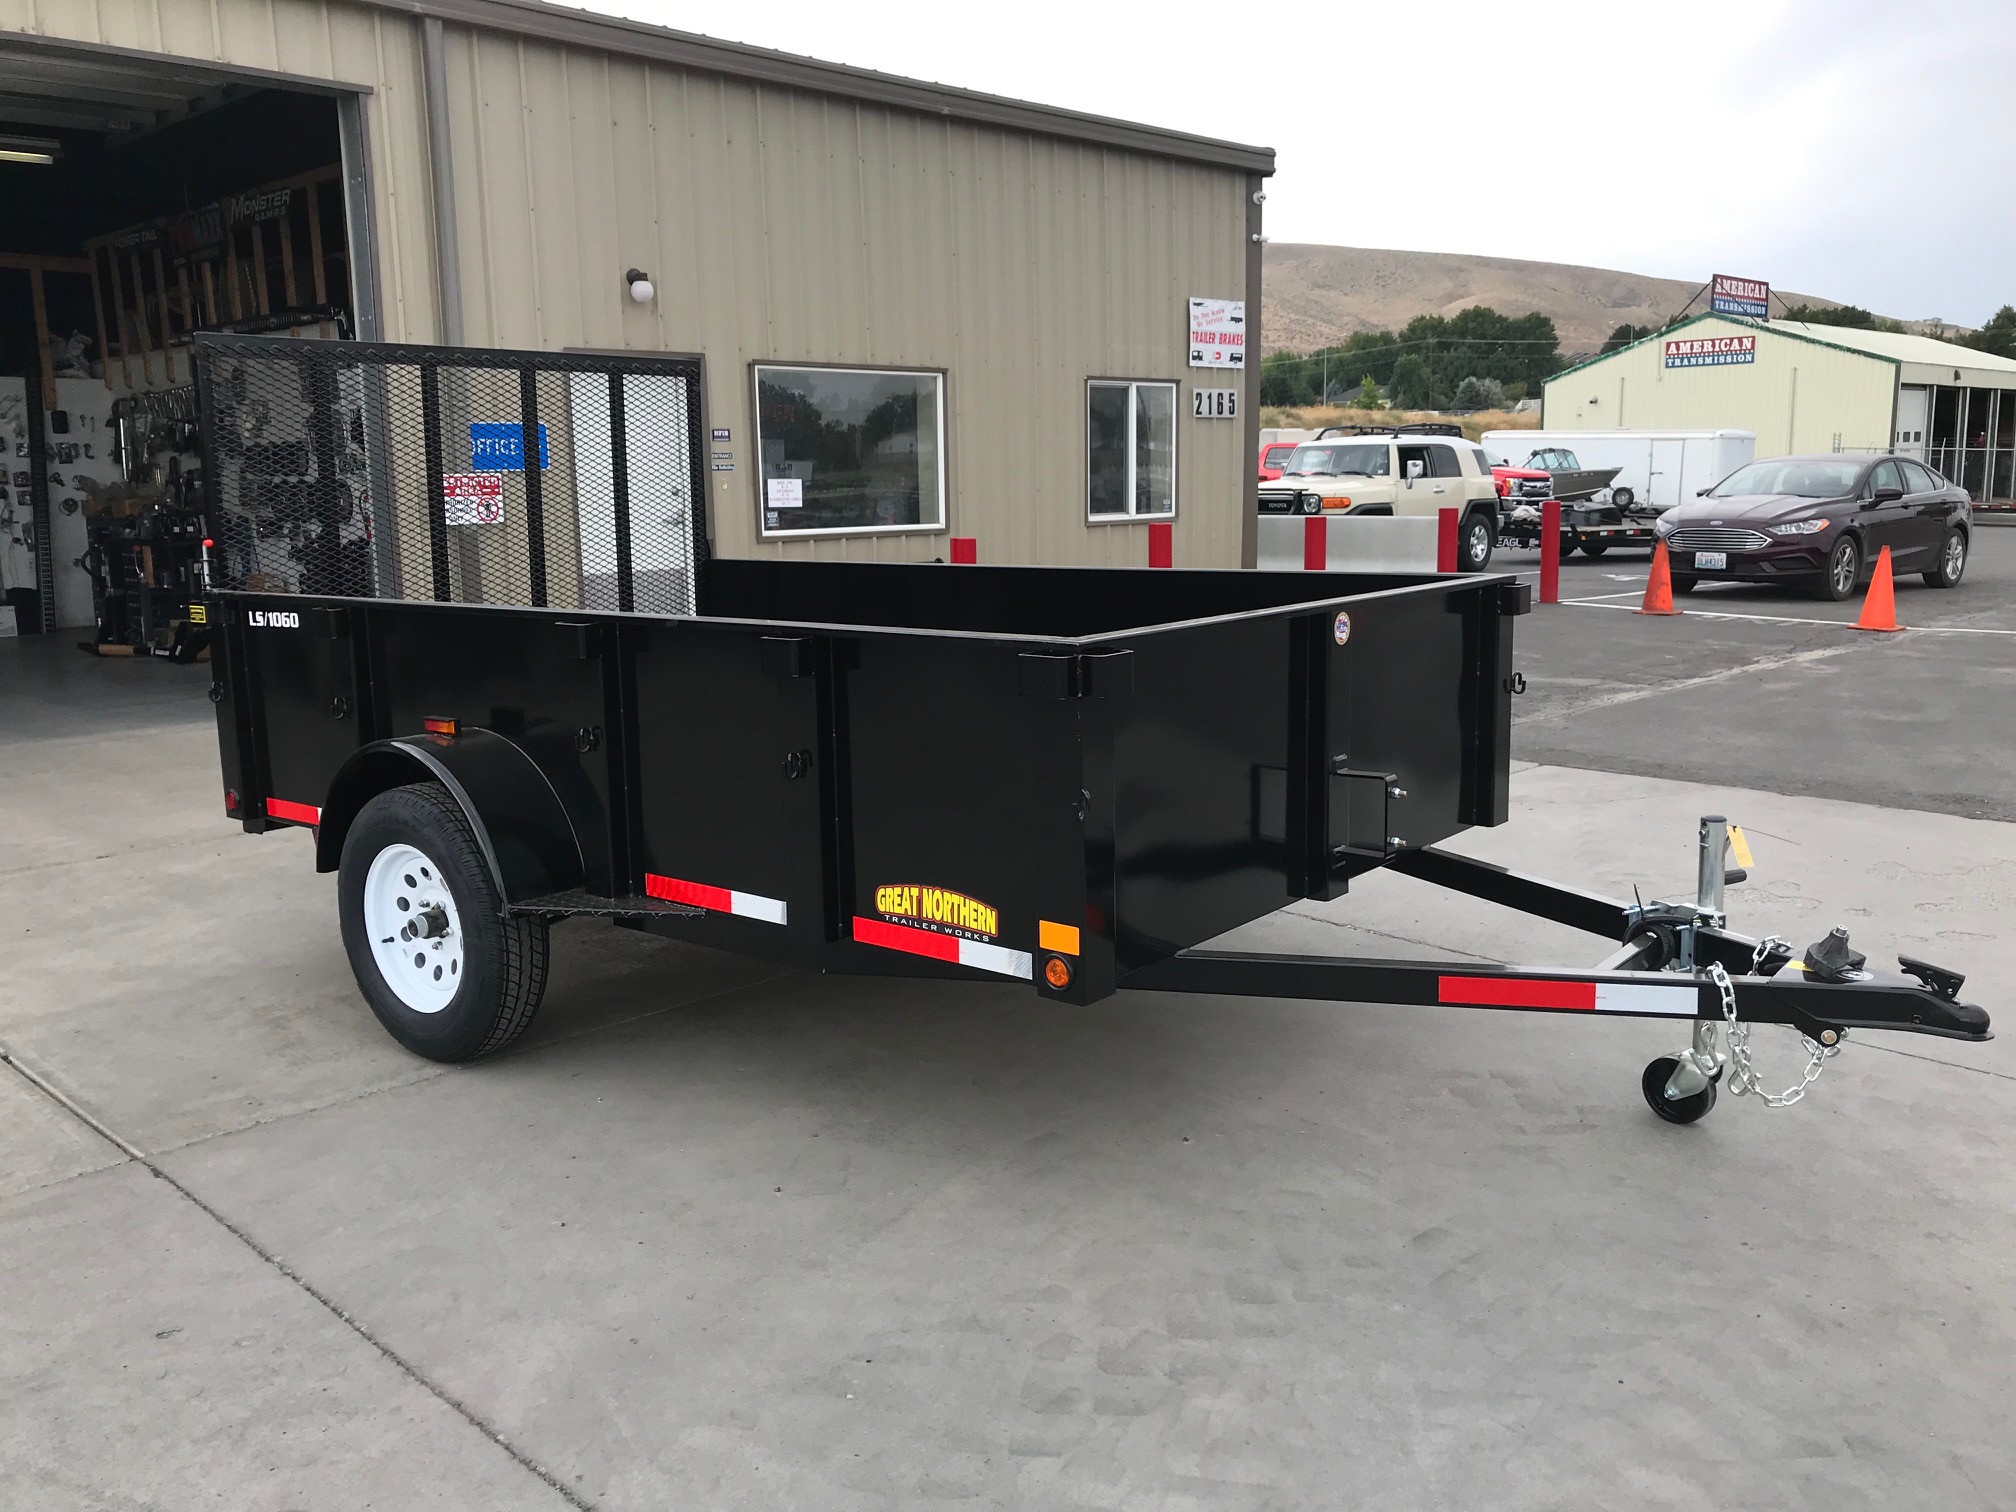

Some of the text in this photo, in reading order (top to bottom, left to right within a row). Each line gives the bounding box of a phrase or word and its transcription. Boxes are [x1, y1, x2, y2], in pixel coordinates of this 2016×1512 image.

[230, 188, 291, 224] MONSTER
[1714, 278, 1767, 299] AMERICAN
[1715, 300, 1767, 315] TRANSMISSION
[1192, 331, 1243, 346] TRAILER BRAKES
[1667, 337, 1754, 355] AMERICAN
[1667, 353, 1753, 367] TRANSMISSION
[1195, 392, 1235, 416] 2165
[443, 477, 499, 487] ESTRICTED
[876, 886, 997, 935] GREAT NORTHERN
[884, 914, 990, 942] TRAILER WORKS
